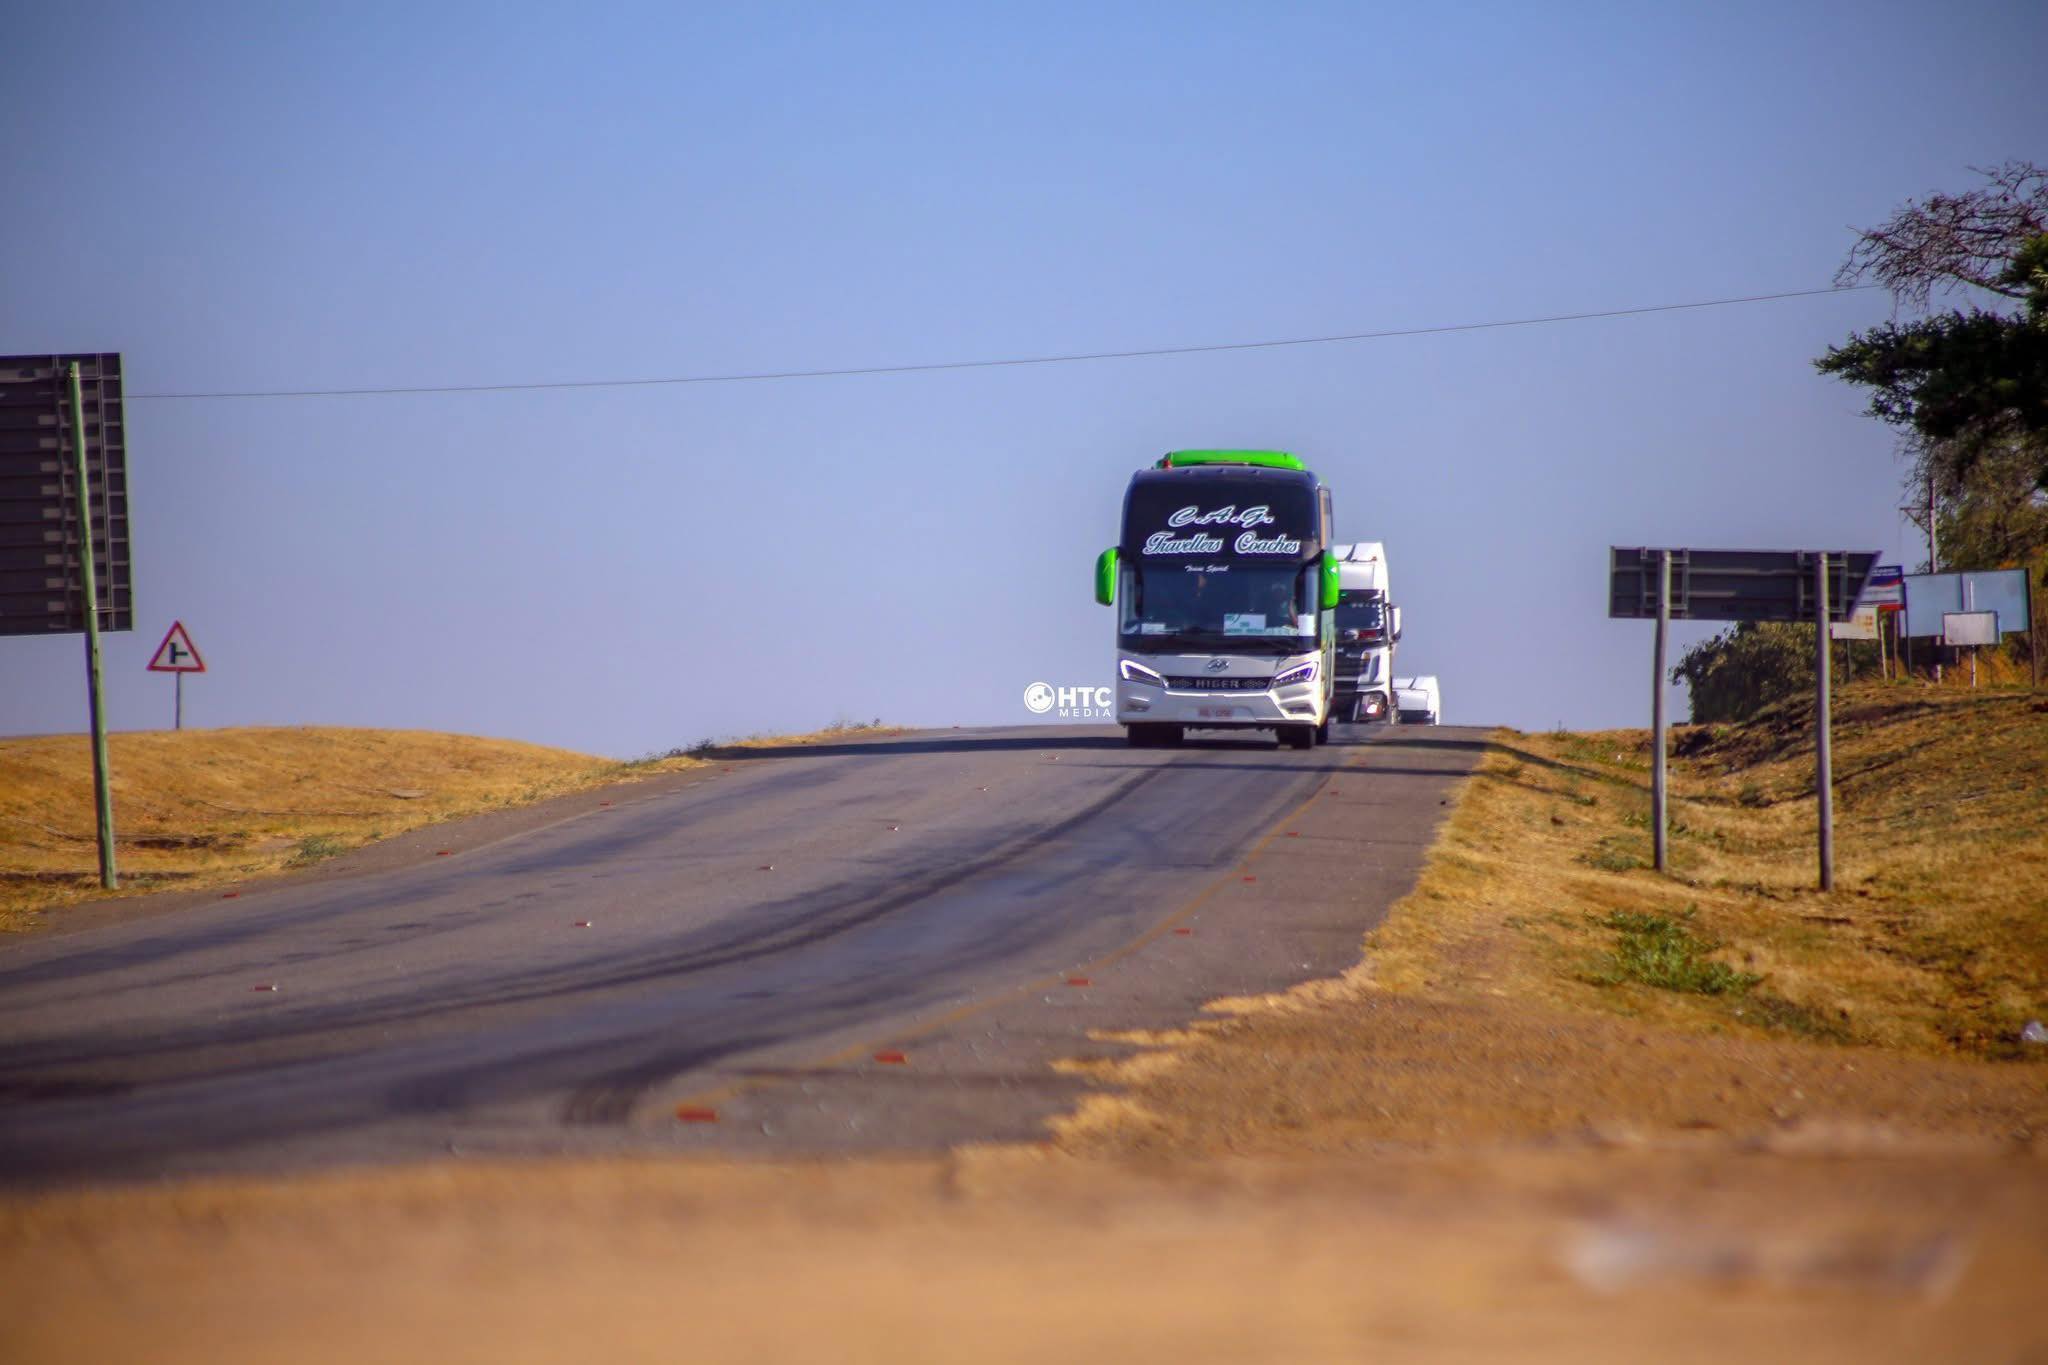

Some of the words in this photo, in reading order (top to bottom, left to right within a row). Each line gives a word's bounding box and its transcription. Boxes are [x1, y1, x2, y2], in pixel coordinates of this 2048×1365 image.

[1142, 530, 1224, 555] Travellers
[1234, 530, 1300, 554] Coaches
[1195, 679, 1240, 688] HIGER
